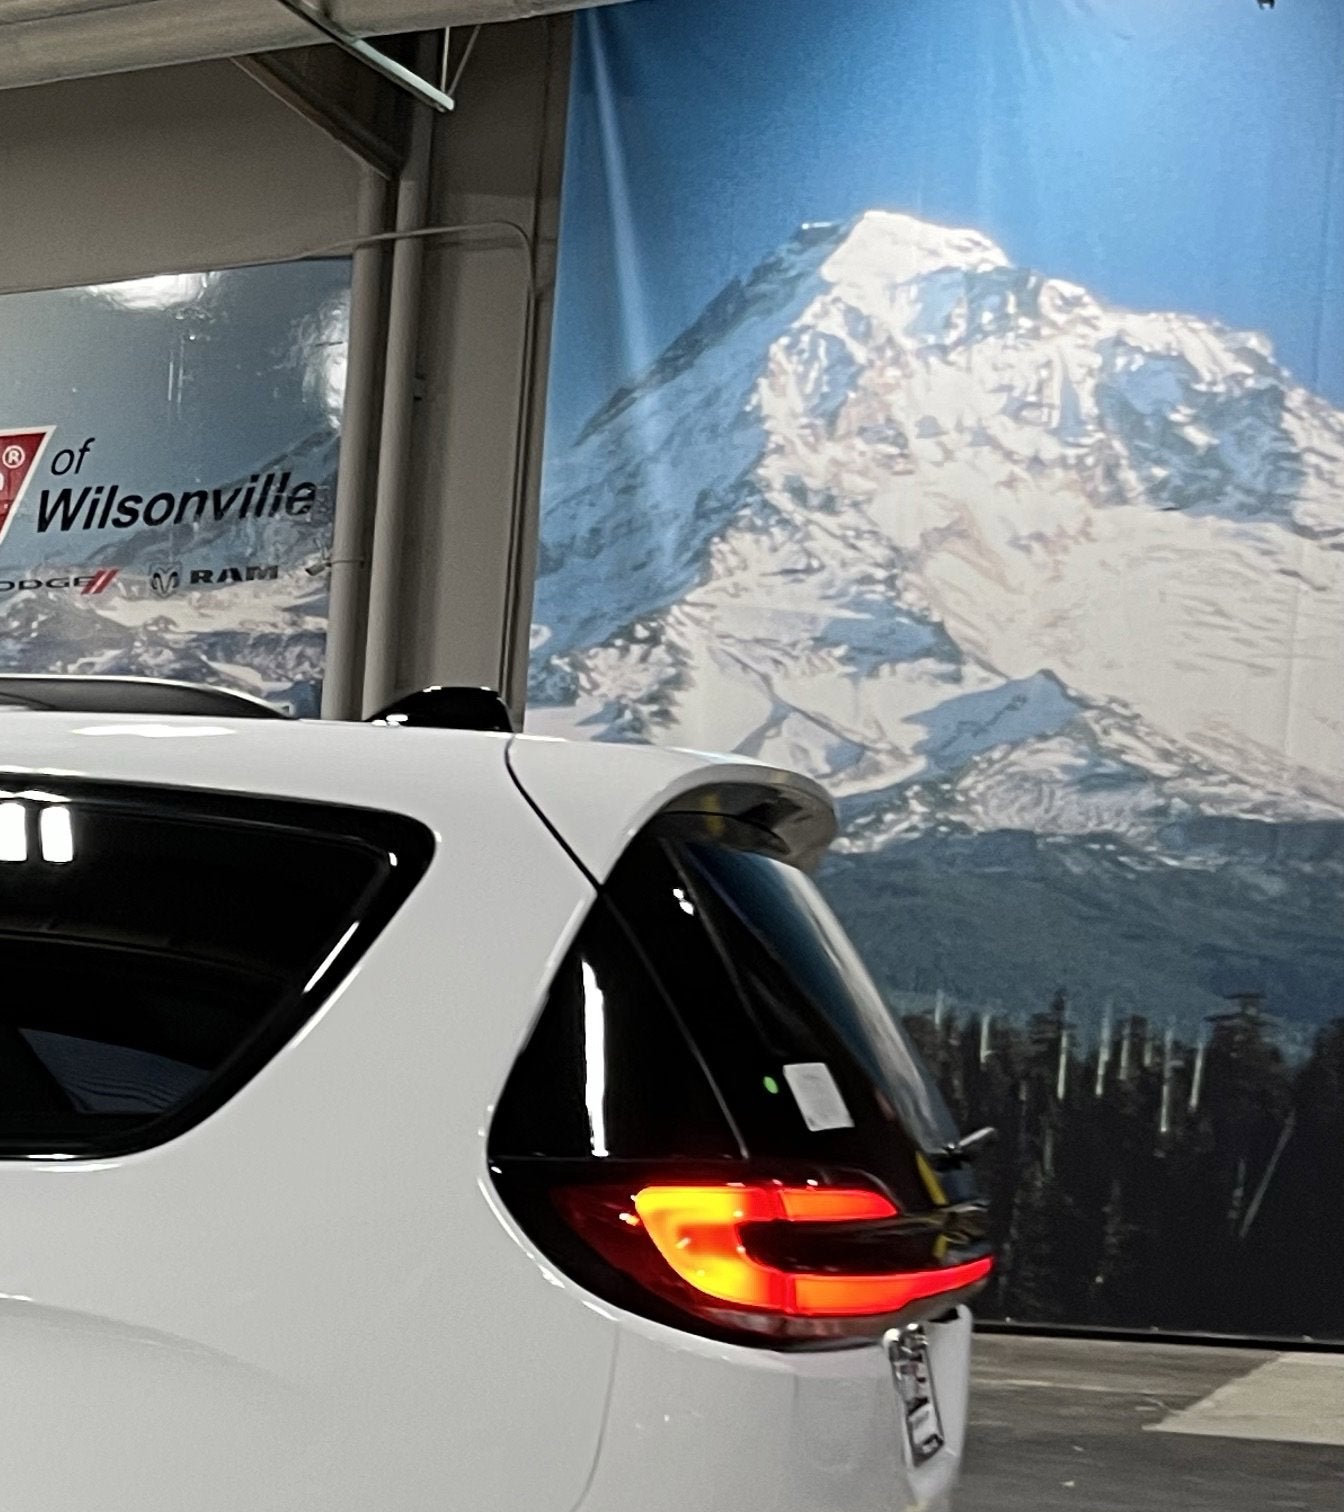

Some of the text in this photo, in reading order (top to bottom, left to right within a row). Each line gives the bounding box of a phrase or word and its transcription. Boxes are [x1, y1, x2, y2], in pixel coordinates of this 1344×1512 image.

[49, 437, 95, 476] of
[37, 472, 317, 533] Wilsonville
[189, 565, 279, 585] RAM
